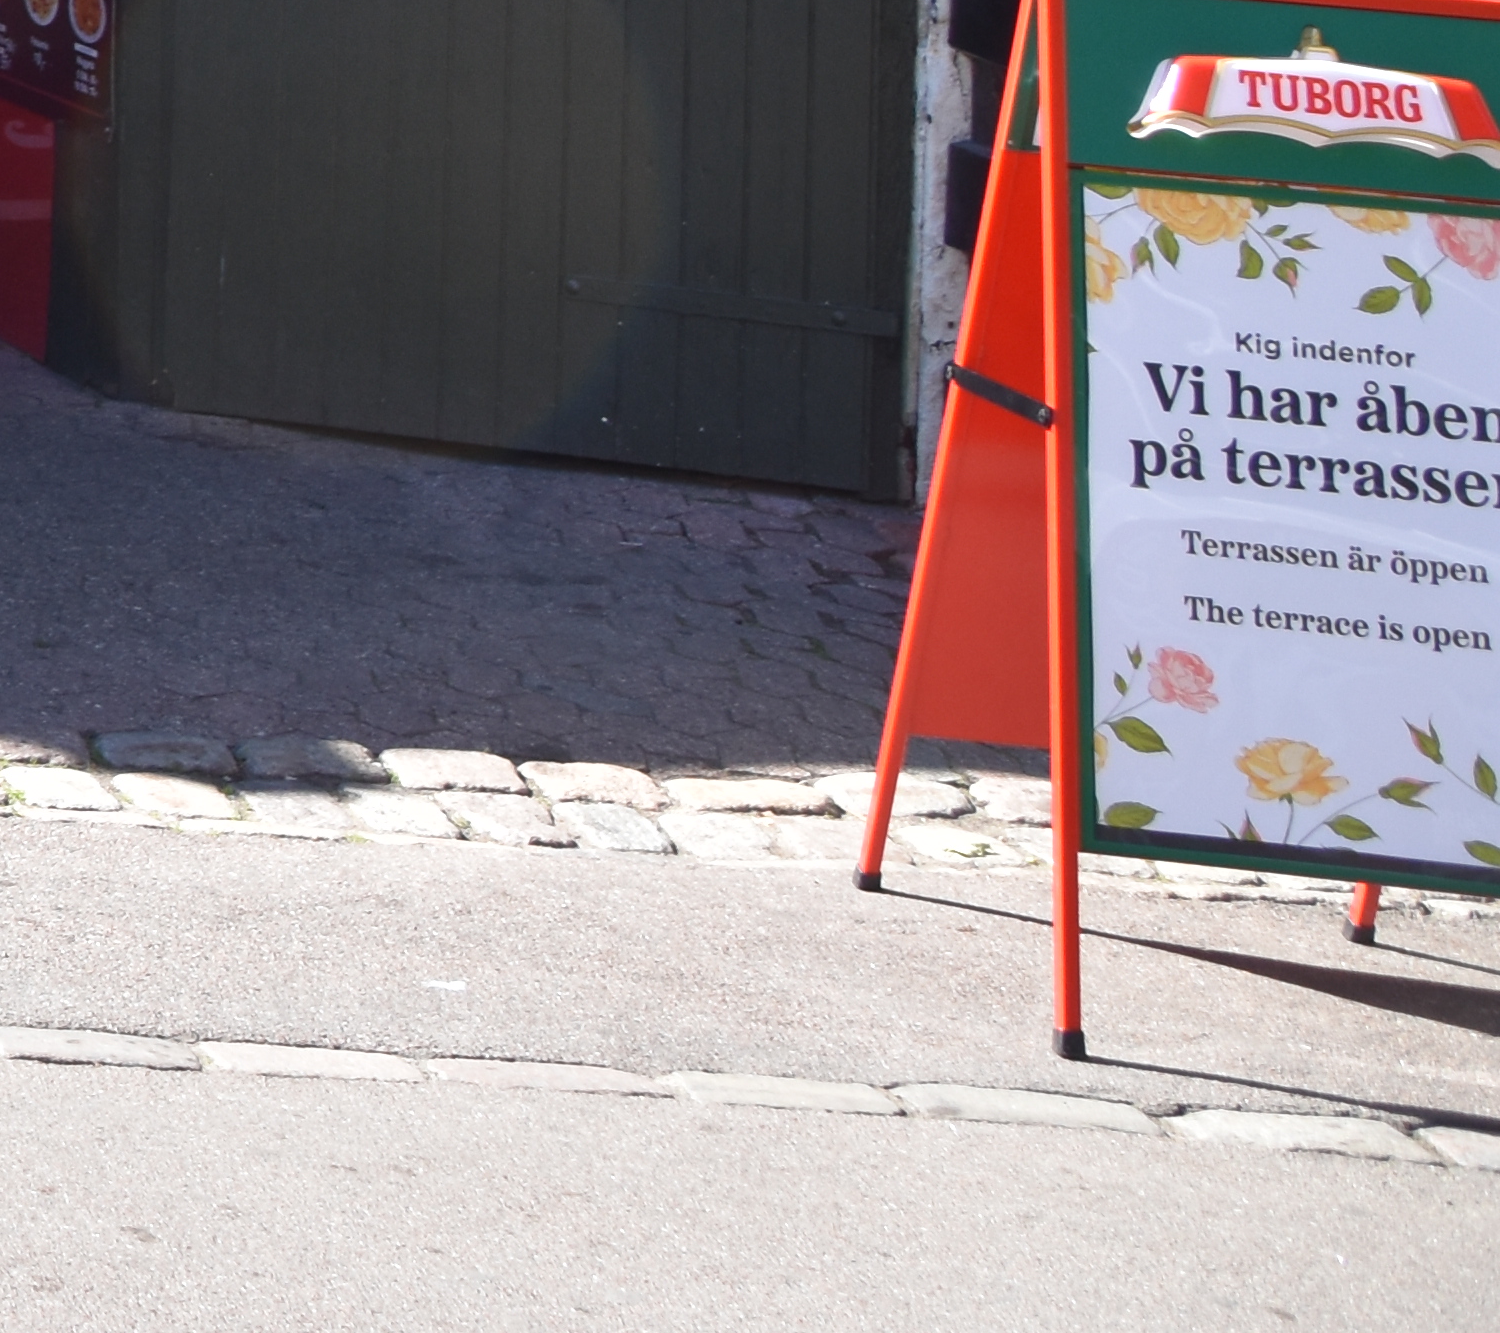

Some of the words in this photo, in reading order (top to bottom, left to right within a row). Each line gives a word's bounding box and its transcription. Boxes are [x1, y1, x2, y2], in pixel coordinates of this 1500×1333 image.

[1238, 69, 1423, 125] TUBORG
[1234, 330, 1285, 365] Kig
[1292, 336, 1417, 371] indenfor
[1143, 361, 1210, 418] Vi
[1227, 365, 1338, 427] har
[1129, 430, 1205, 494] på
[1220, 437, 1500, 509] terrasse
[1180, 527, 1340, 574] Terrassen
[1346, 545, 1382, 574] är
[1390, 549, 1490, 586] öppen
[1183, 595, 1243, 630] The
[1251, 602, 1371, 642] terrace
[1377, 613, 1405, 642] is
[1412, 623, 1493, 653] open
